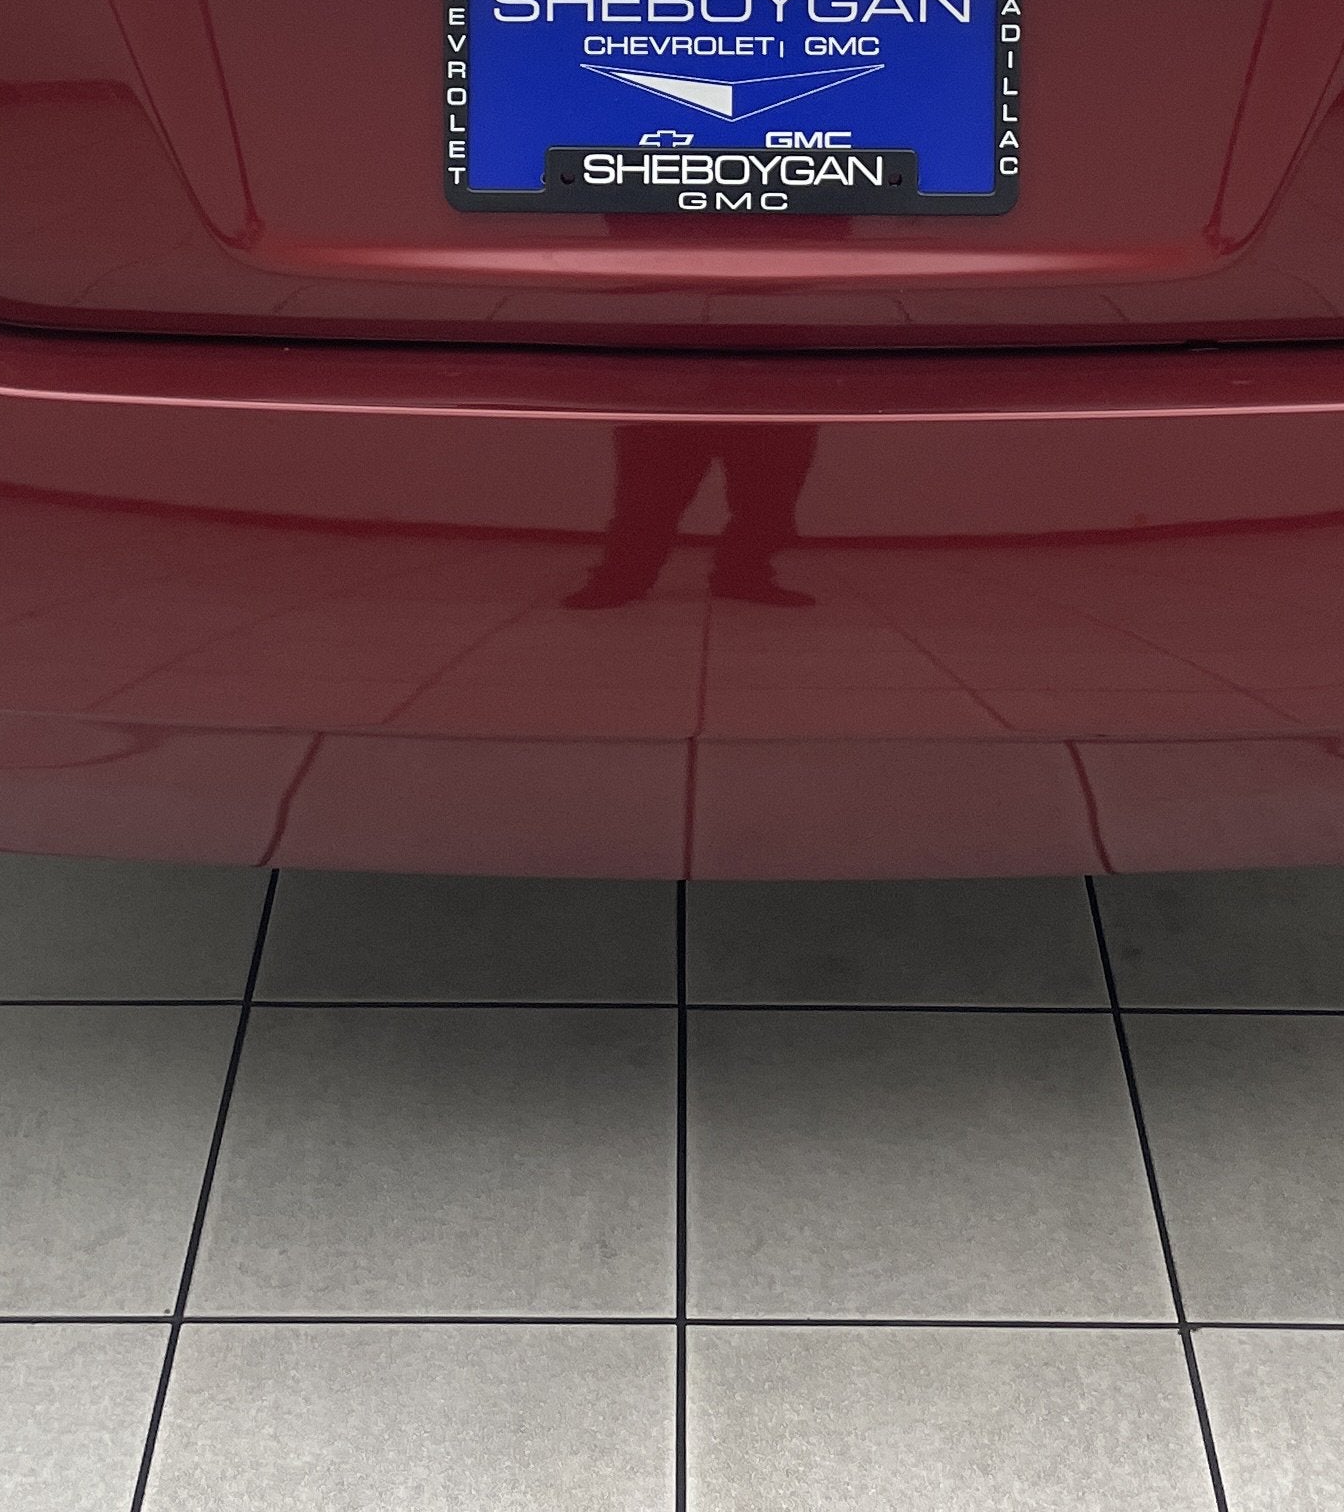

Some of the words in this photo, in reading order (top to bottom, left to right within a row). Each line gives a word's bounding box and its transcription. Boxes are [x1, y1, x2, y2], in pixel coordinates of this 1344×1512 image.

[583, 35, 775, 57] CHEVROLET
[804, 35, 880, 57] GMC
[765, 131, 852, 149] GMC
[582, 153, 884, 187] SHEBOYGAN
[678, 190, 789, 212] GMC
